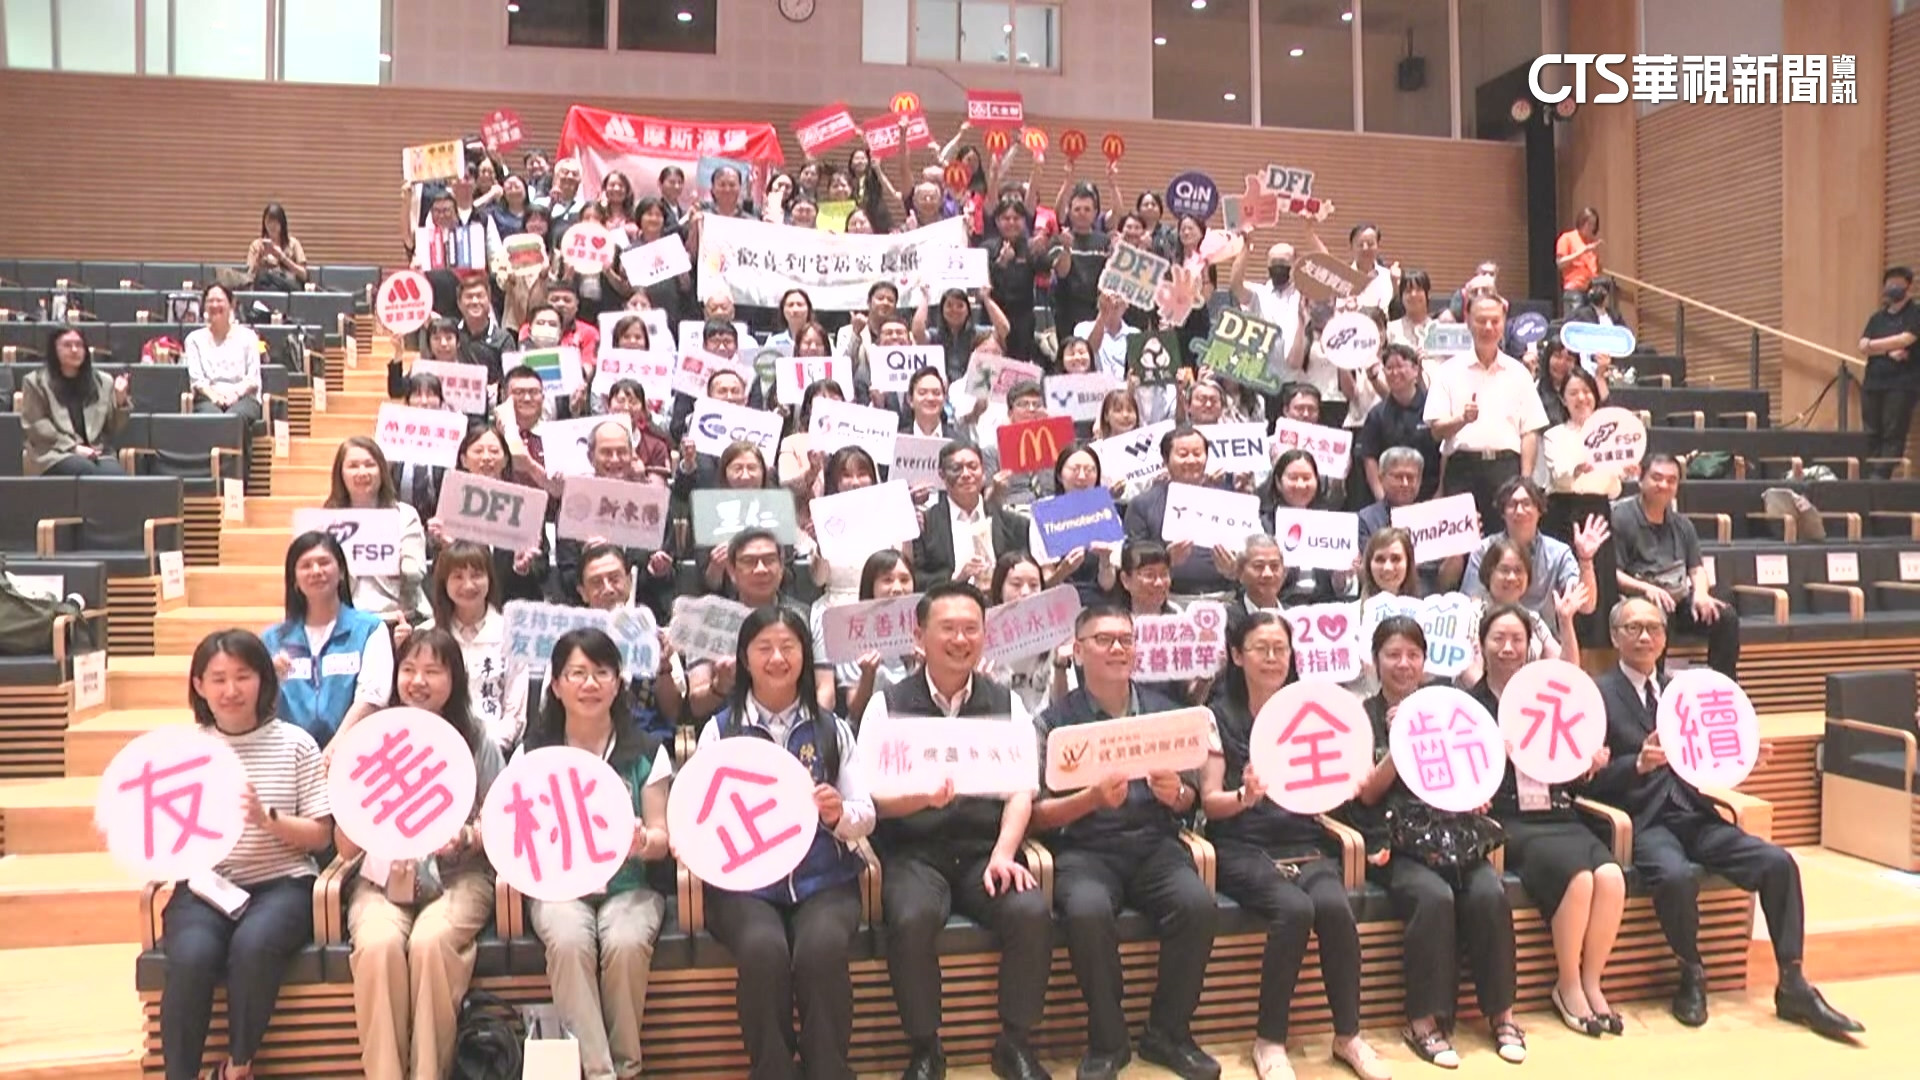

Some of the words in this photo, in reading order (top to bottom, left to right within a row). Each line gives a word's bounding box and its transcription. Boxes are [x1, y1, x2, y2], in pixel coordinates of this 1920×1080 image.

[1266, 167, 1312, 195] DFI
[1215, 311, 1276, 353] DFI
[459, 484, 525, 527] DFI
[1308, 535, 1350, 550] USUN
[352, 544, 395, 560] FSP
[1135, 623, 1195, 644] 請成為
[1430, 642, 1465, 667] UP
[1276, 701, 1350, 791] 全
[1407, 707, 1491, 791] 齡
[1520, 680, 1587, 761] 永
[1675, 689, 1745, 770] 續
[118, 755, 223, 860] 友
[350, 728, 453, 839] 善
[504, 767, 616, 881] 桃
[697, 767, 801, 874] 企
